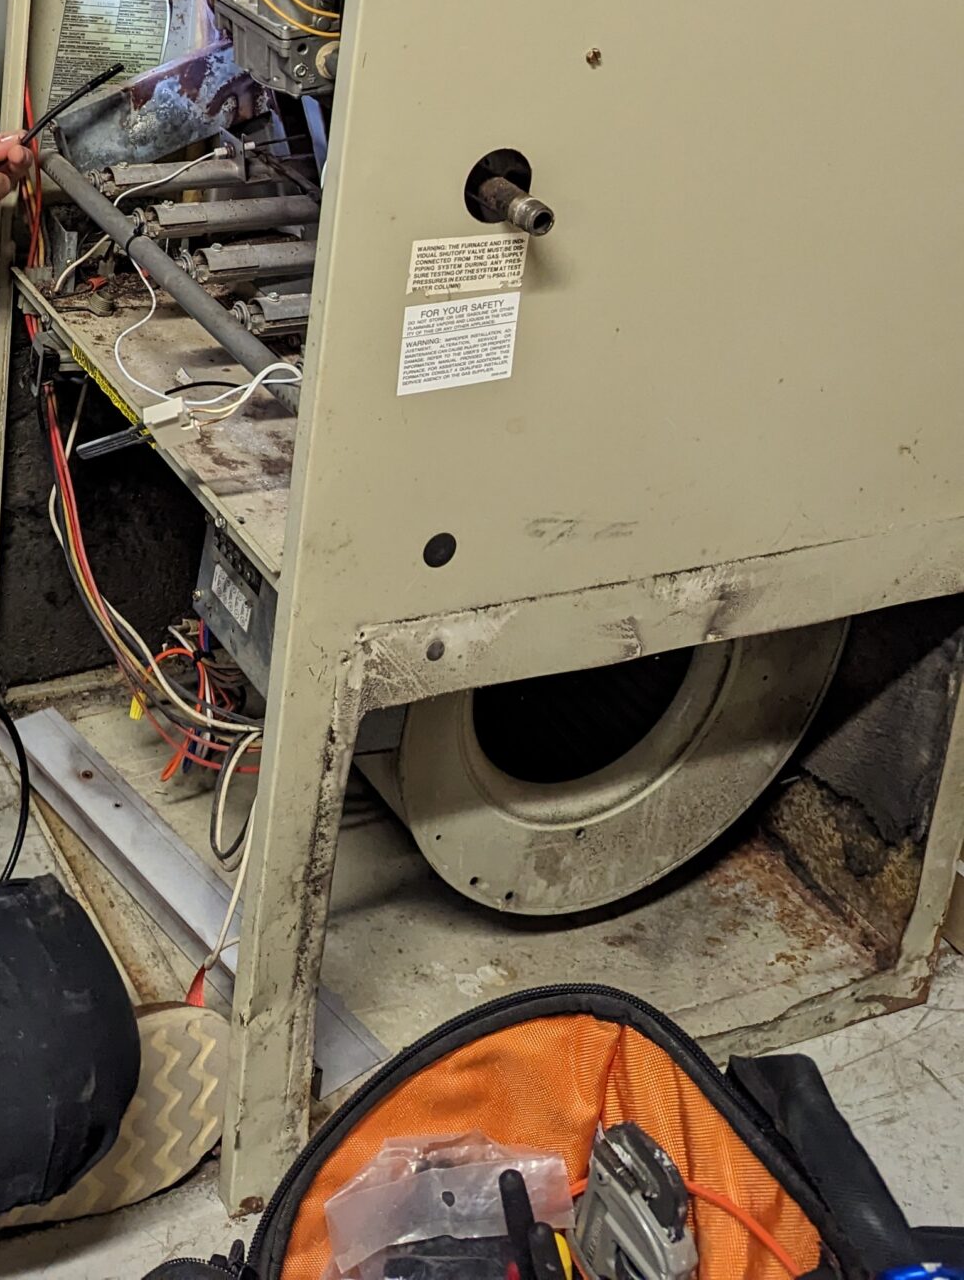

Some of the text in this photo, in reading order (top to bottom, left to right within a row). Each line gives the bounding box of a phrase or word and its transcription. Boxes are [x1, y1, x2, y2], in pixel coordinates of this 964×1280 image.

[421, 300, 504, 318] FOR YOUR SAFETY
[406, 338, 441, 348] WARNING:
